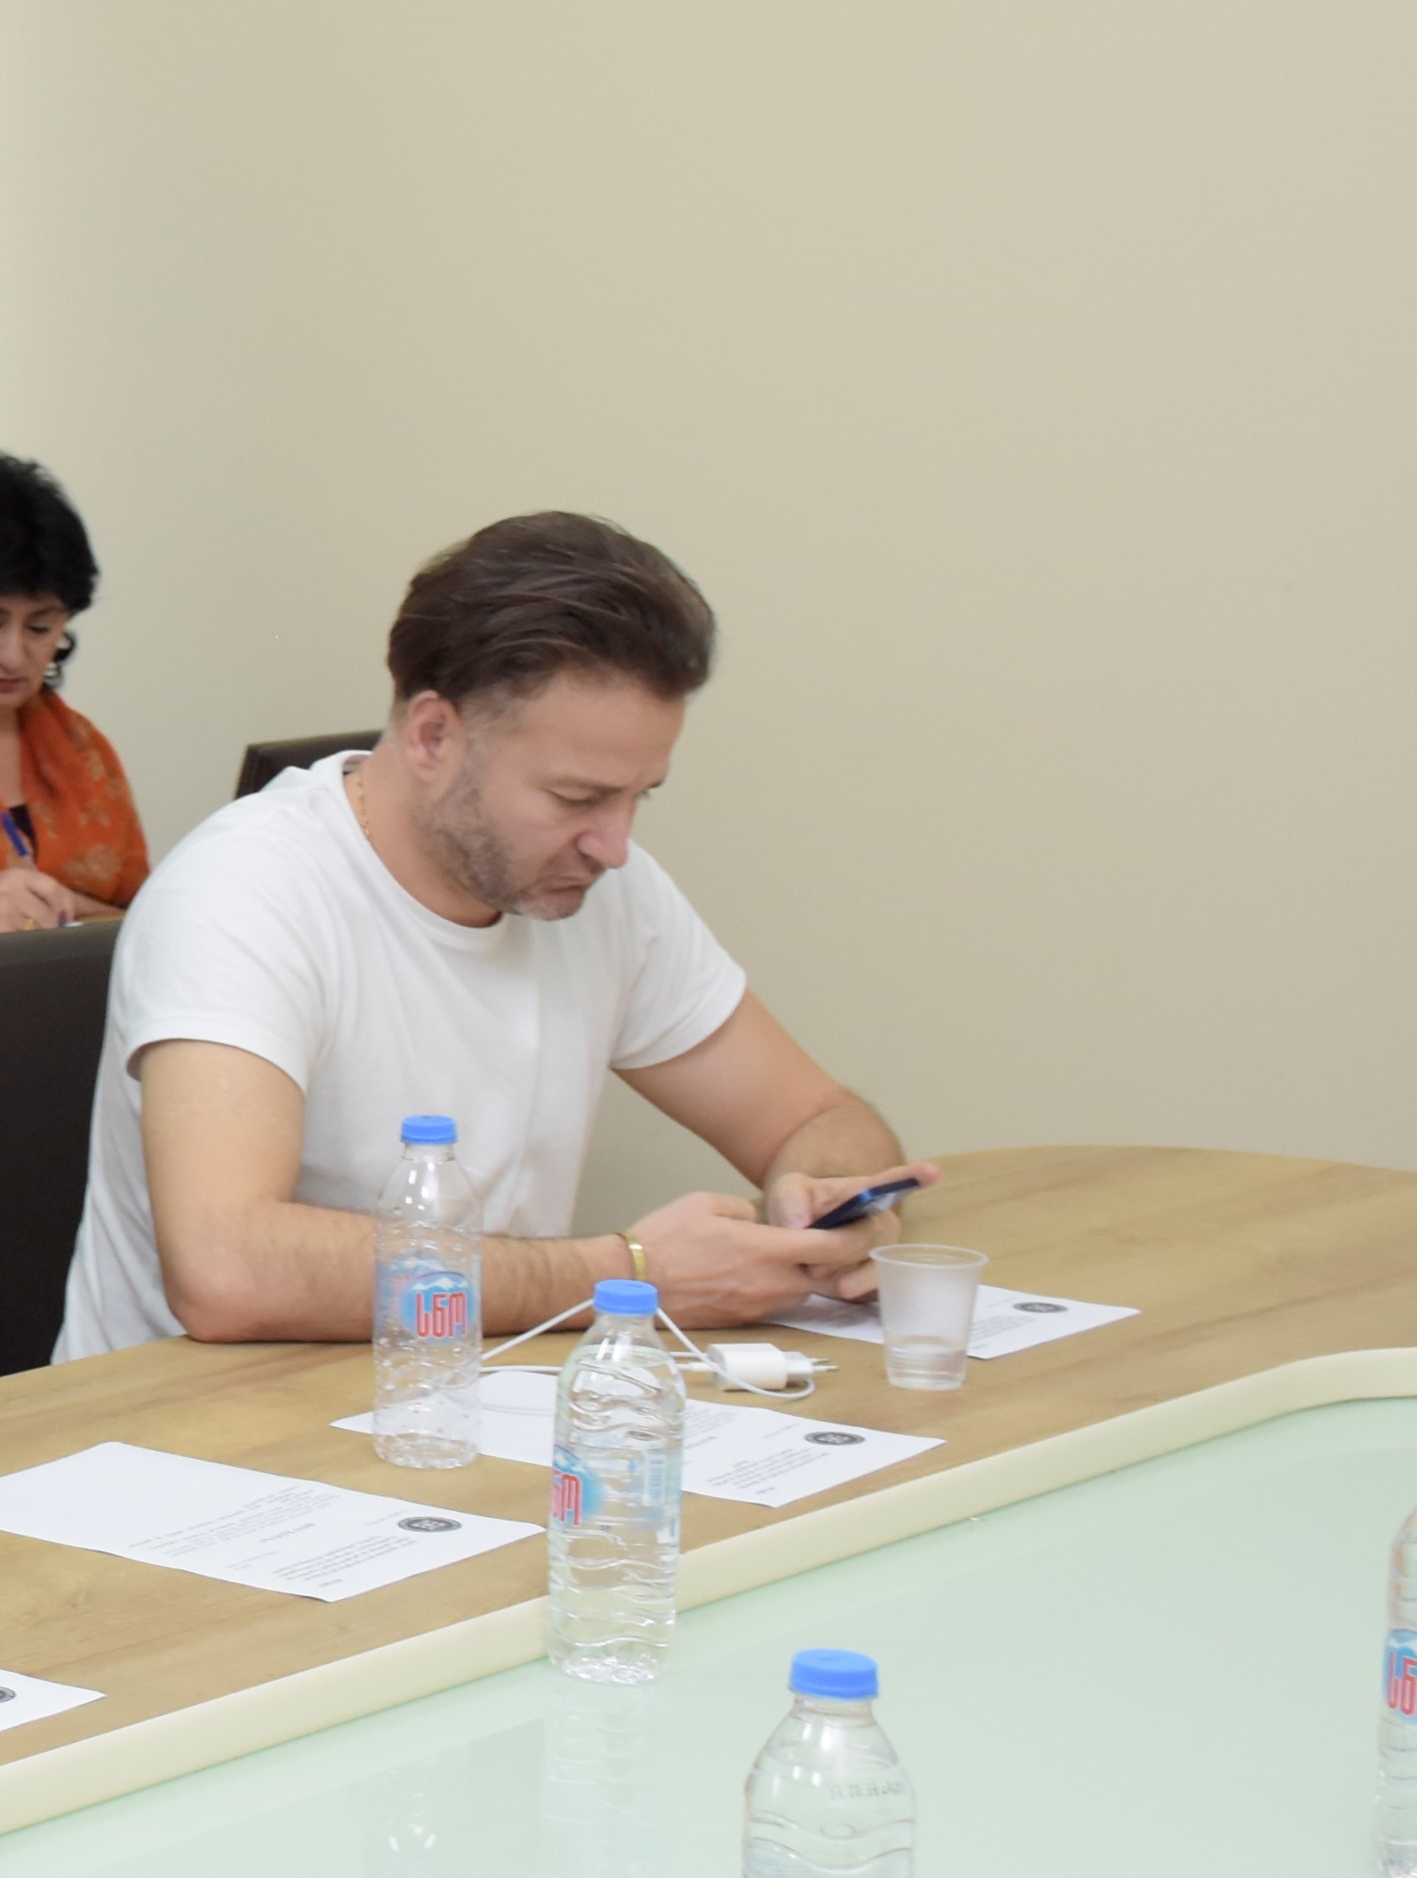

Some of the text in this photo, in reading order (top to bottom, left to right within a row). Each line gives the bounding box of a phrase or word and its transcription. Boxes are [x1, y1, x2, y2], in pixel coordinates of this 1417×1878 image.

[416, 1292, 467, 1338] სნო
[552, 1470, 581, 1526] ნო
[1387, 1650, 1417, 1715] სნ
